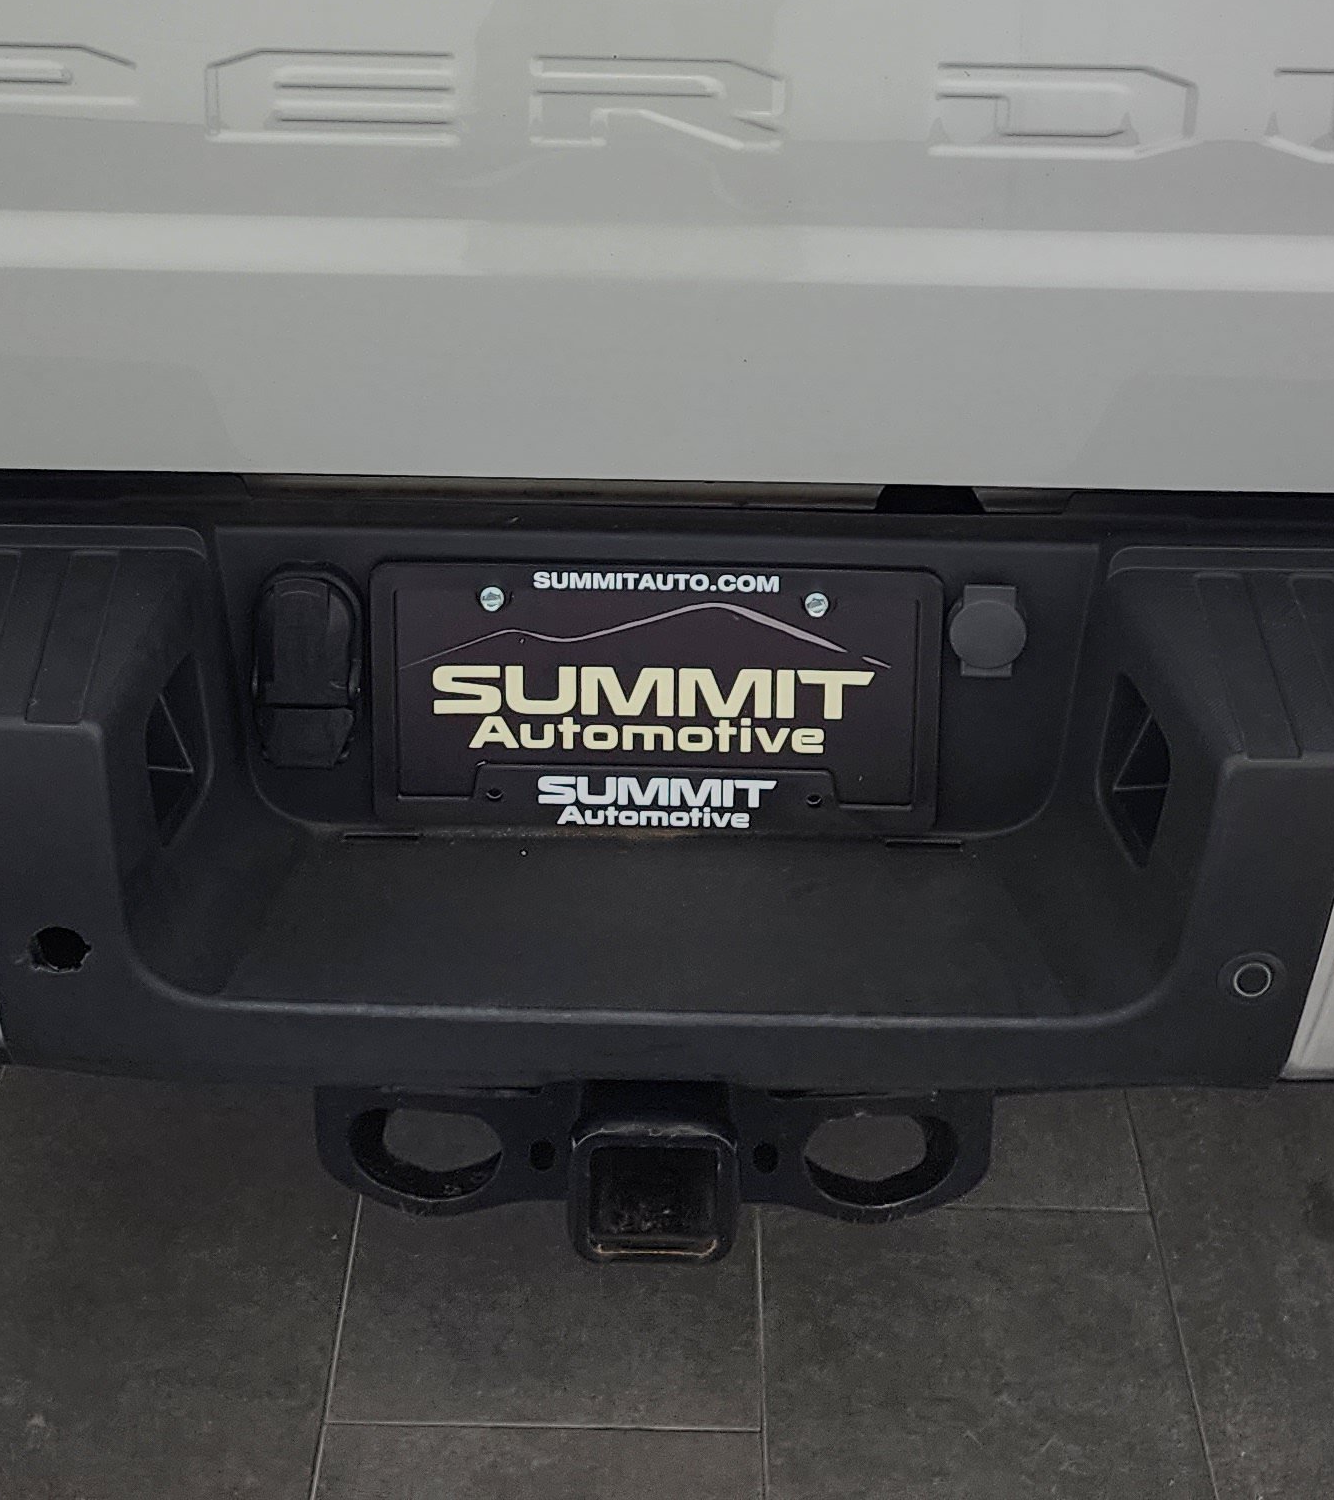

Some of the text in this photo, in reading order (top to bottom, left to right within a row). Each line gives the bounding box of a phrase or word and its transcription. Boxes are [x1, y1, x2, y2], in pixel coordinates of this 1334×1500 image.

[532, 570, 781, 595] SUMMITAUTO.COM
[432, 665, 876, 721] SUMMIT
[468, 714, 826, 756] Automotive
[537, 775, 778, 809] SUMMIT
[556, 806, 751, 829] Automotive
